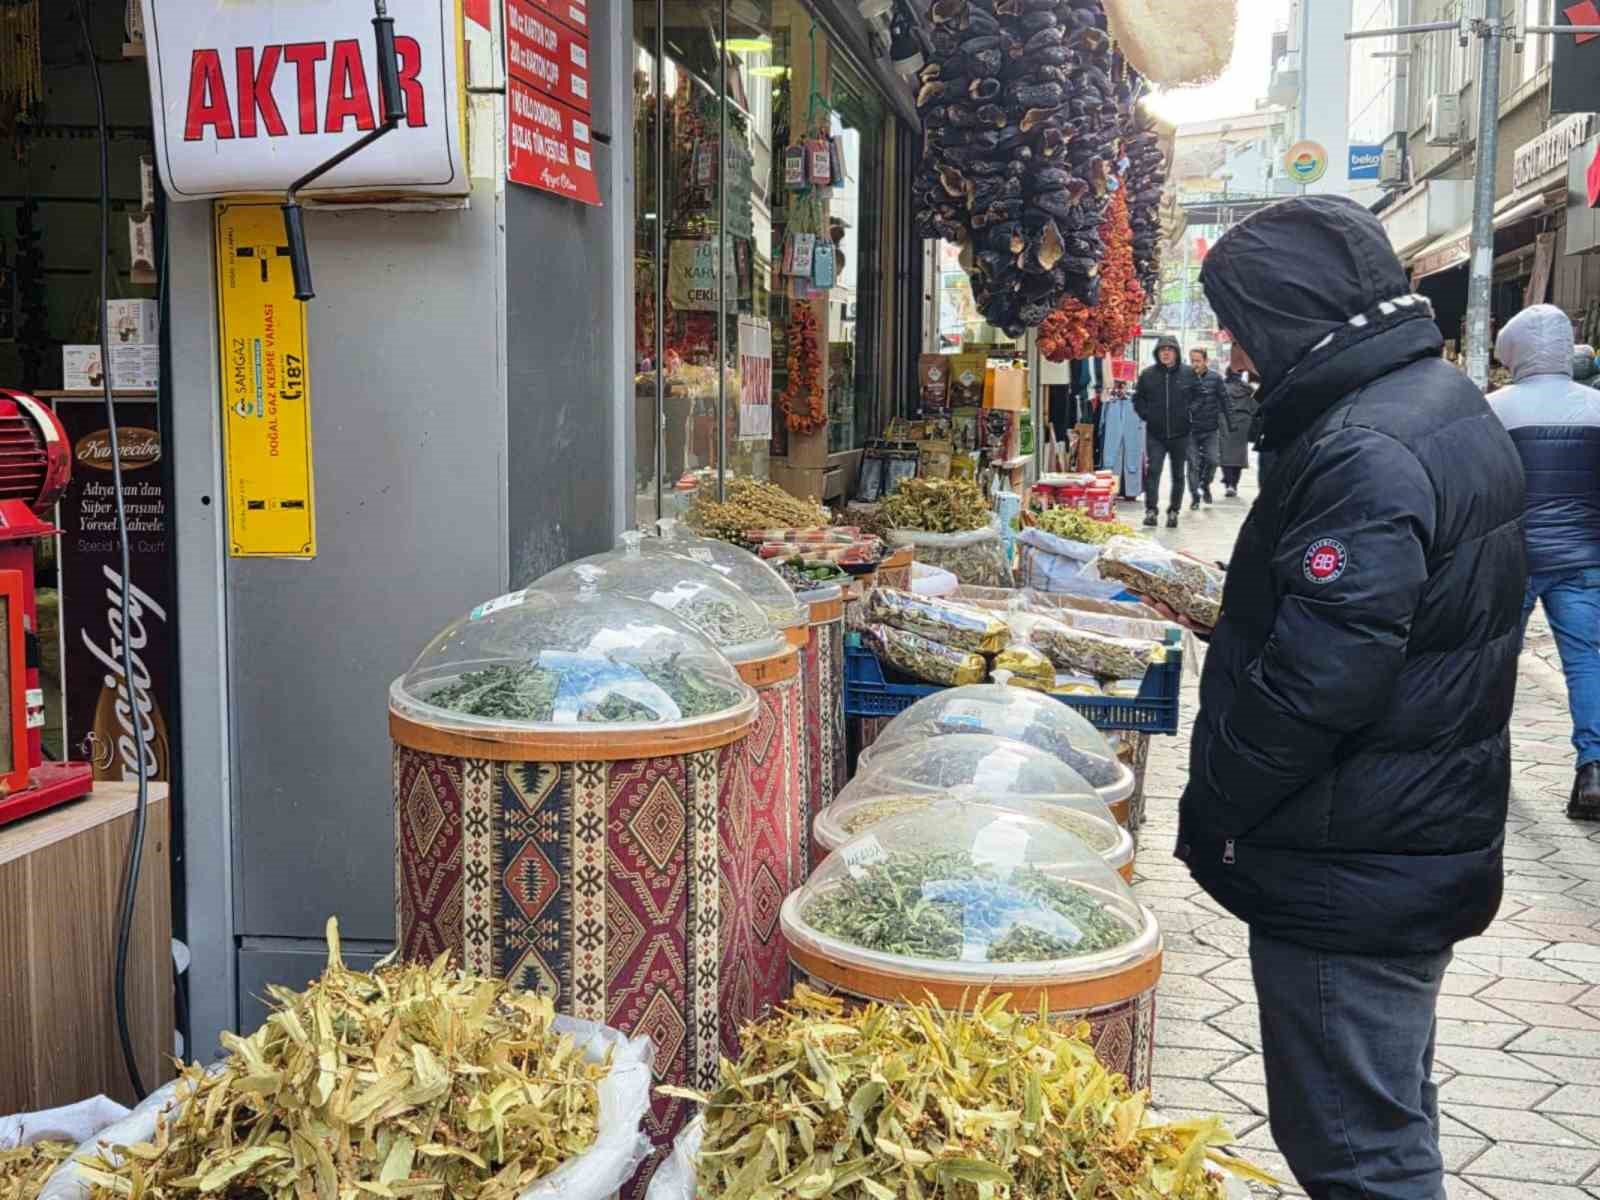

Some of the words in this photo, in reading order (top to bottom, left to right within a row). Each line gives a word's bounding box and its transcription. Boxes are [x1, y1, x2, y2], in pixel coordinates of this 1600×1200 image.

[184, 35, 427, 141] AKTAR
[263, 304, 275, 347] VANASI
[232, 337, 247, 394] SAMGAZ
[265, 351, 276, 389] KESME
[286, 354, 302, 389] 187
[267, 393, 278, 415] GAZ
[267, 420, 279, 456] DOĞAL
